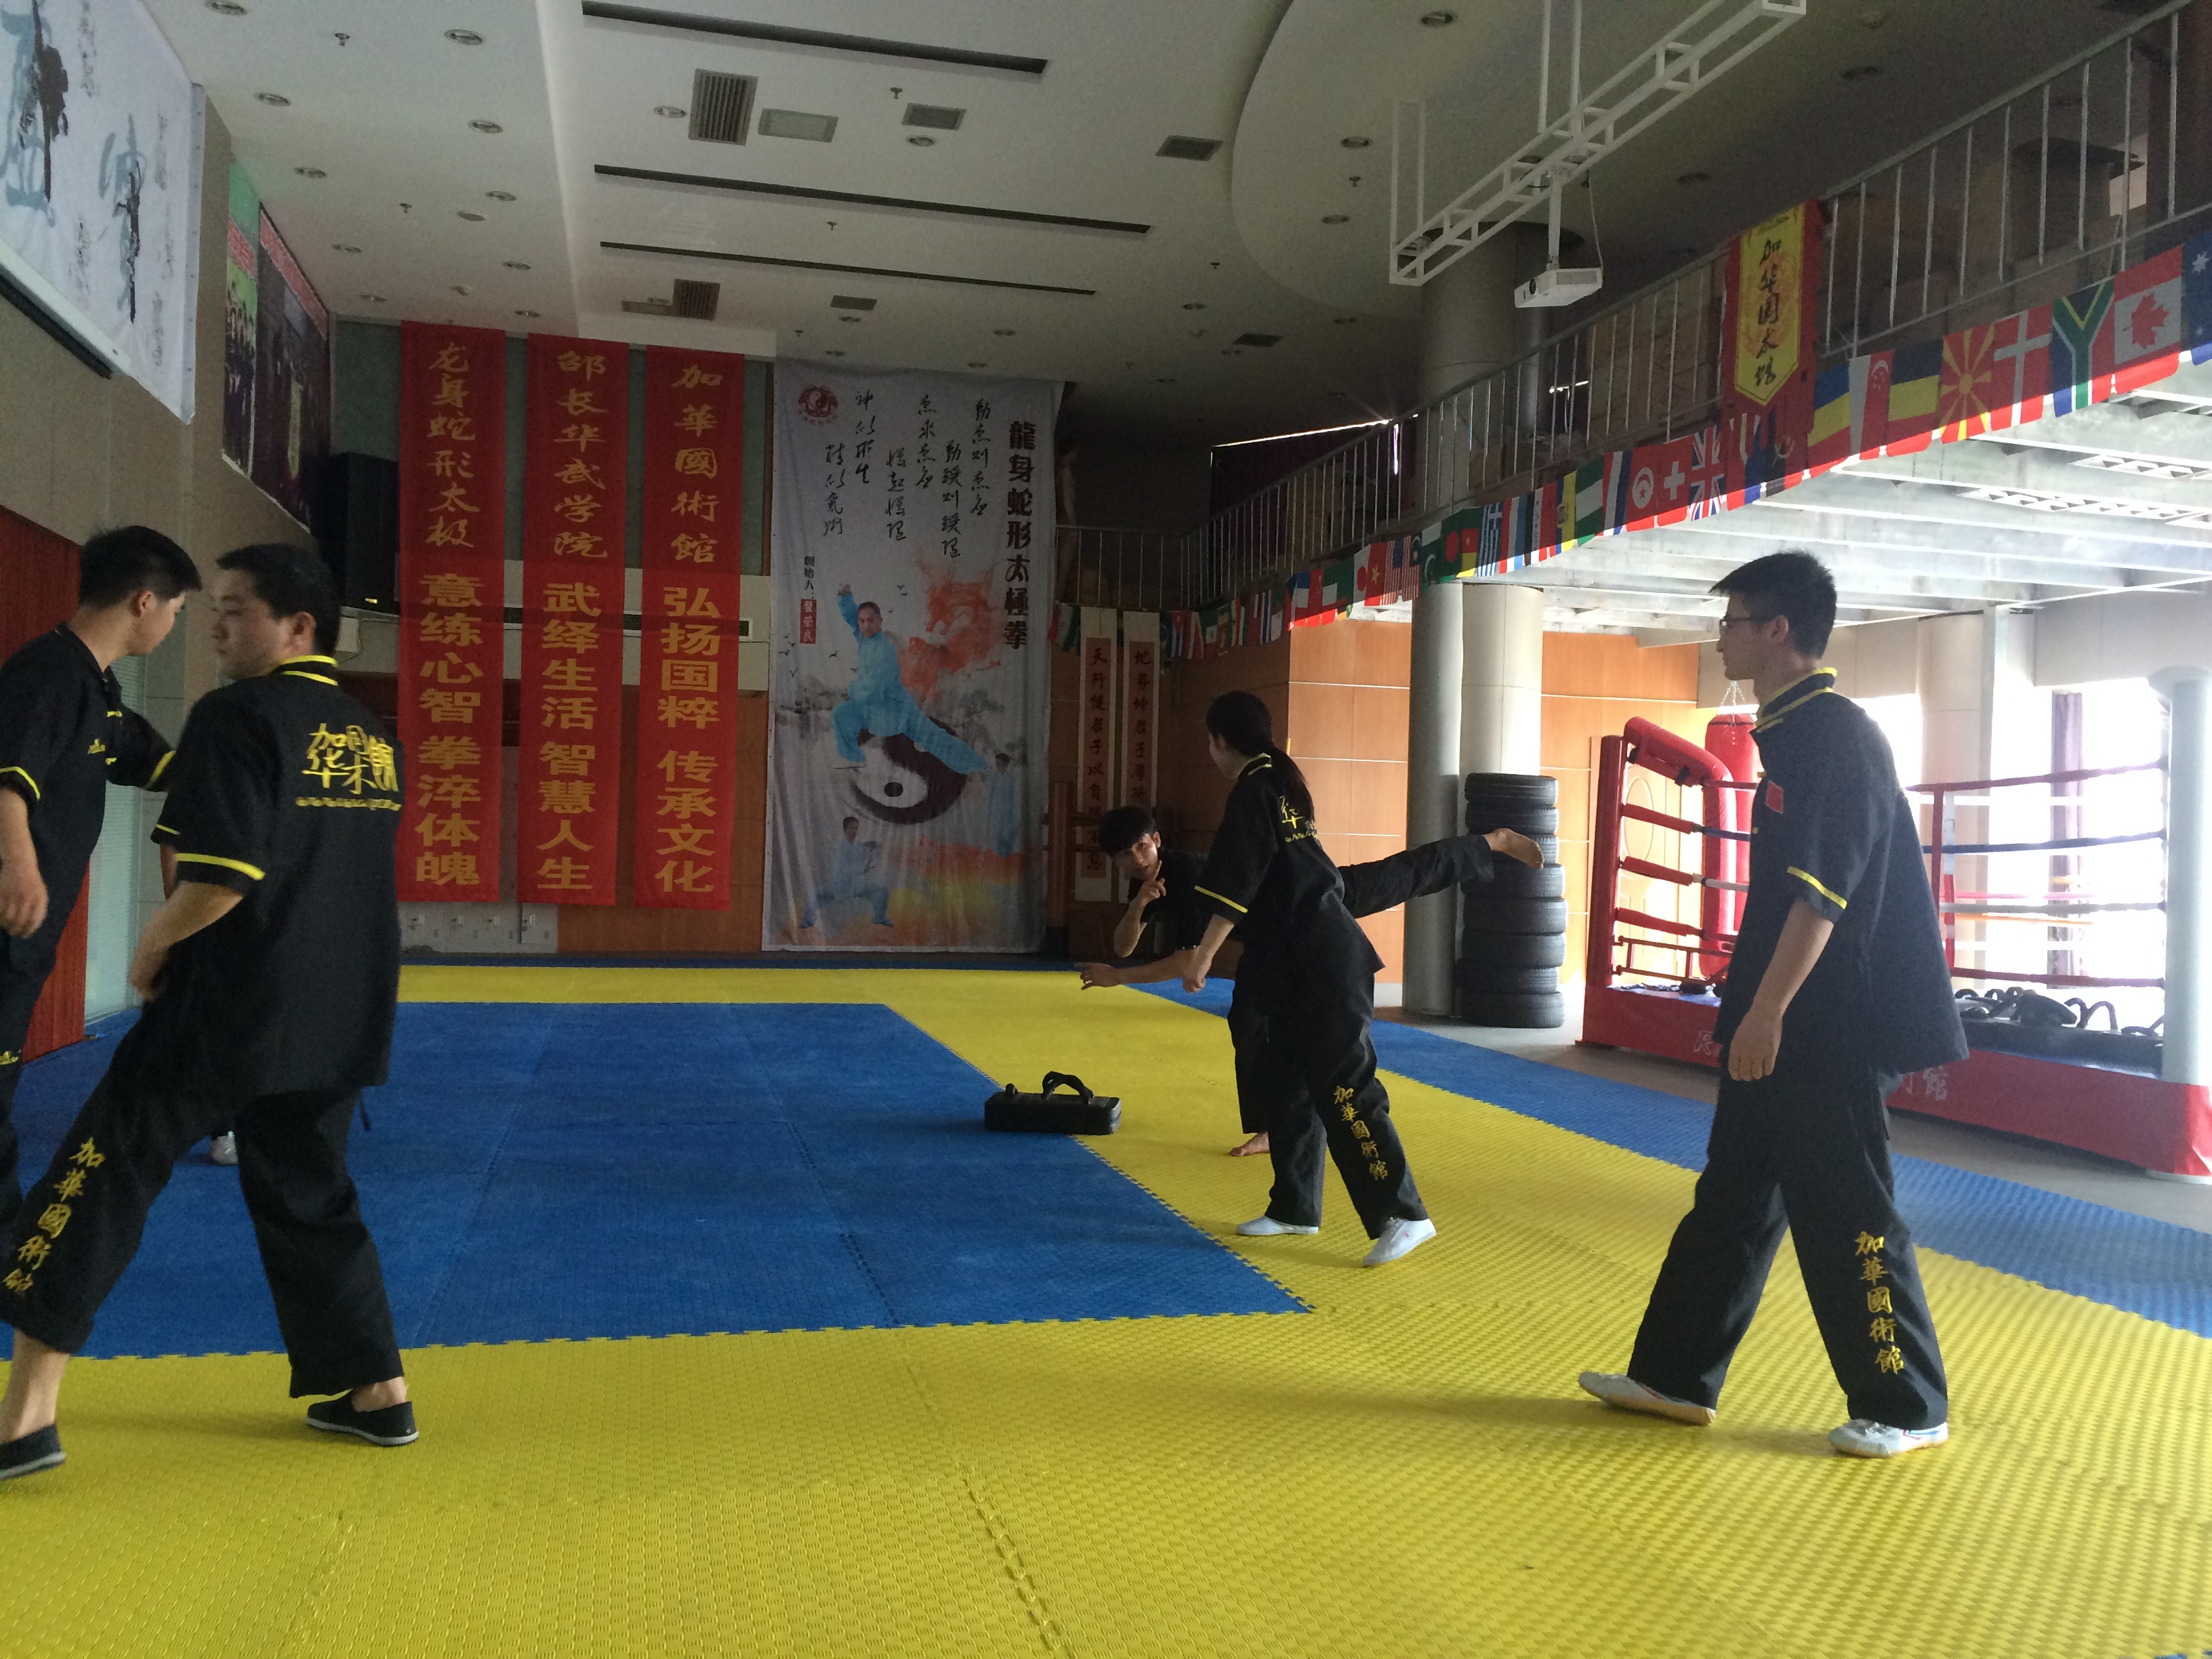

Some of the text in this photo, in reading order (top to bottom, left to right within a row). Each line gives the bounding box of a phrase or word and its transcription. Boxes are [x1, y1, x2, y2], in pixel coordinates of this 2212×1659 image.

[425, 342, 479, 548] 龙身蛇形太极
[553, 350, 609, 558] 邵长华武学院
